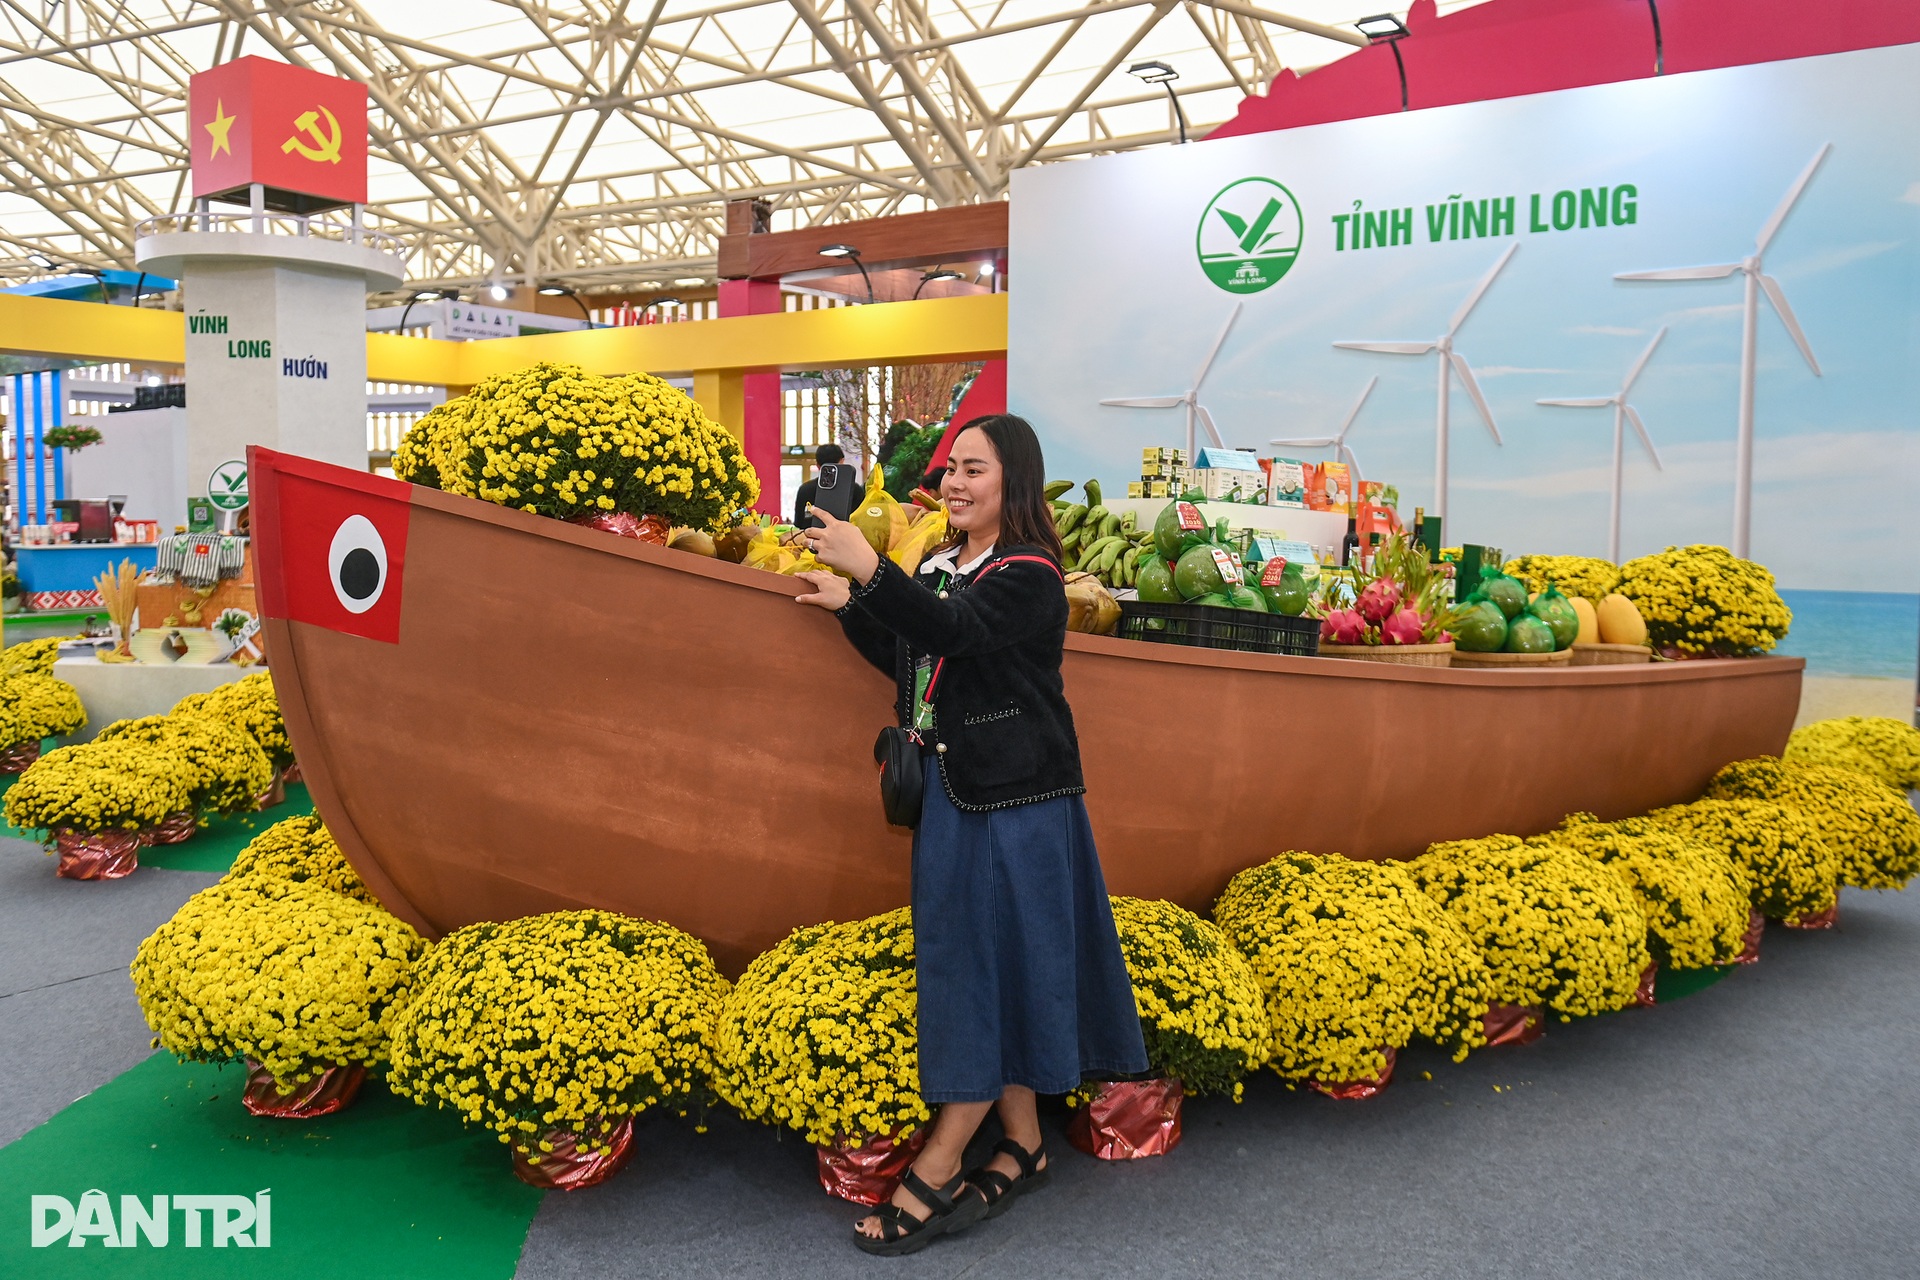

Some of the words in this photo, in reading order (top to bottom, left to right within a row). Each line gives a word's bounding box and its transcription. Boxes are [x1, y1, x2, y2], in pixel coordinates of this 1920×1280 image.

[1332, 199, 1412, 251] TỈNH
[1426, 193, 1515, 242] VĨNH
[1529, 184, 1637, 233] LONG
[188, 309, 229, 334] VĨNH
[228, 339, 271, 359] LONG
[282, 354, 328, 380] HƯỚN
